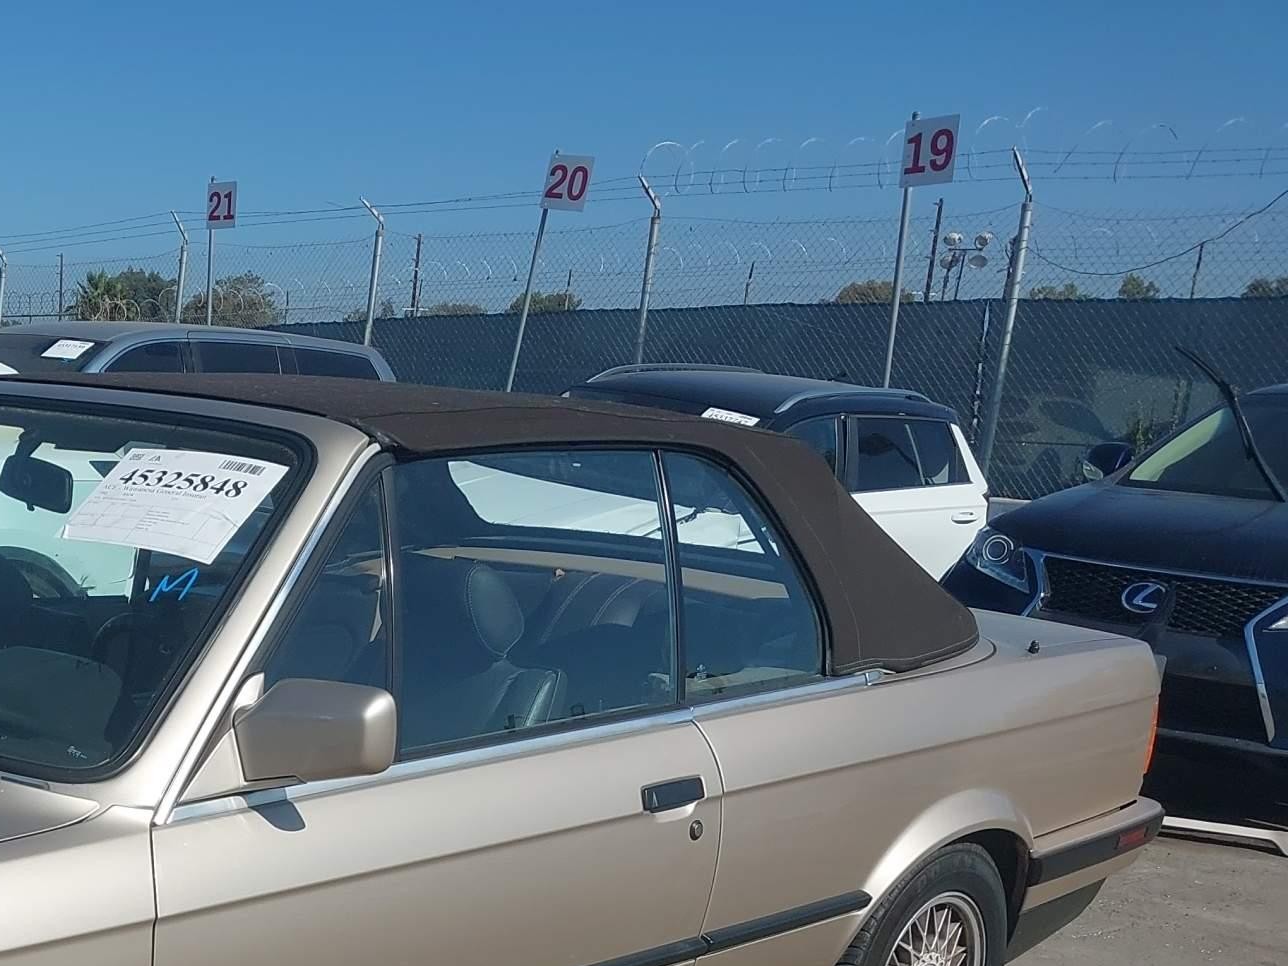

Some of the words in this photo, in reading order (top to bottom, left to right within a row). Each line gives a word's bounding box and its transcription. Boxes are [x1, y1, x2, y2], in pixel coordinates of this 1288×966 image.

[904, 129, 954, 175] 19
[544, 164, 588, 201] 20
[208, 191, 234, 221] 21
[120, 468, 248, 498] 45325848
